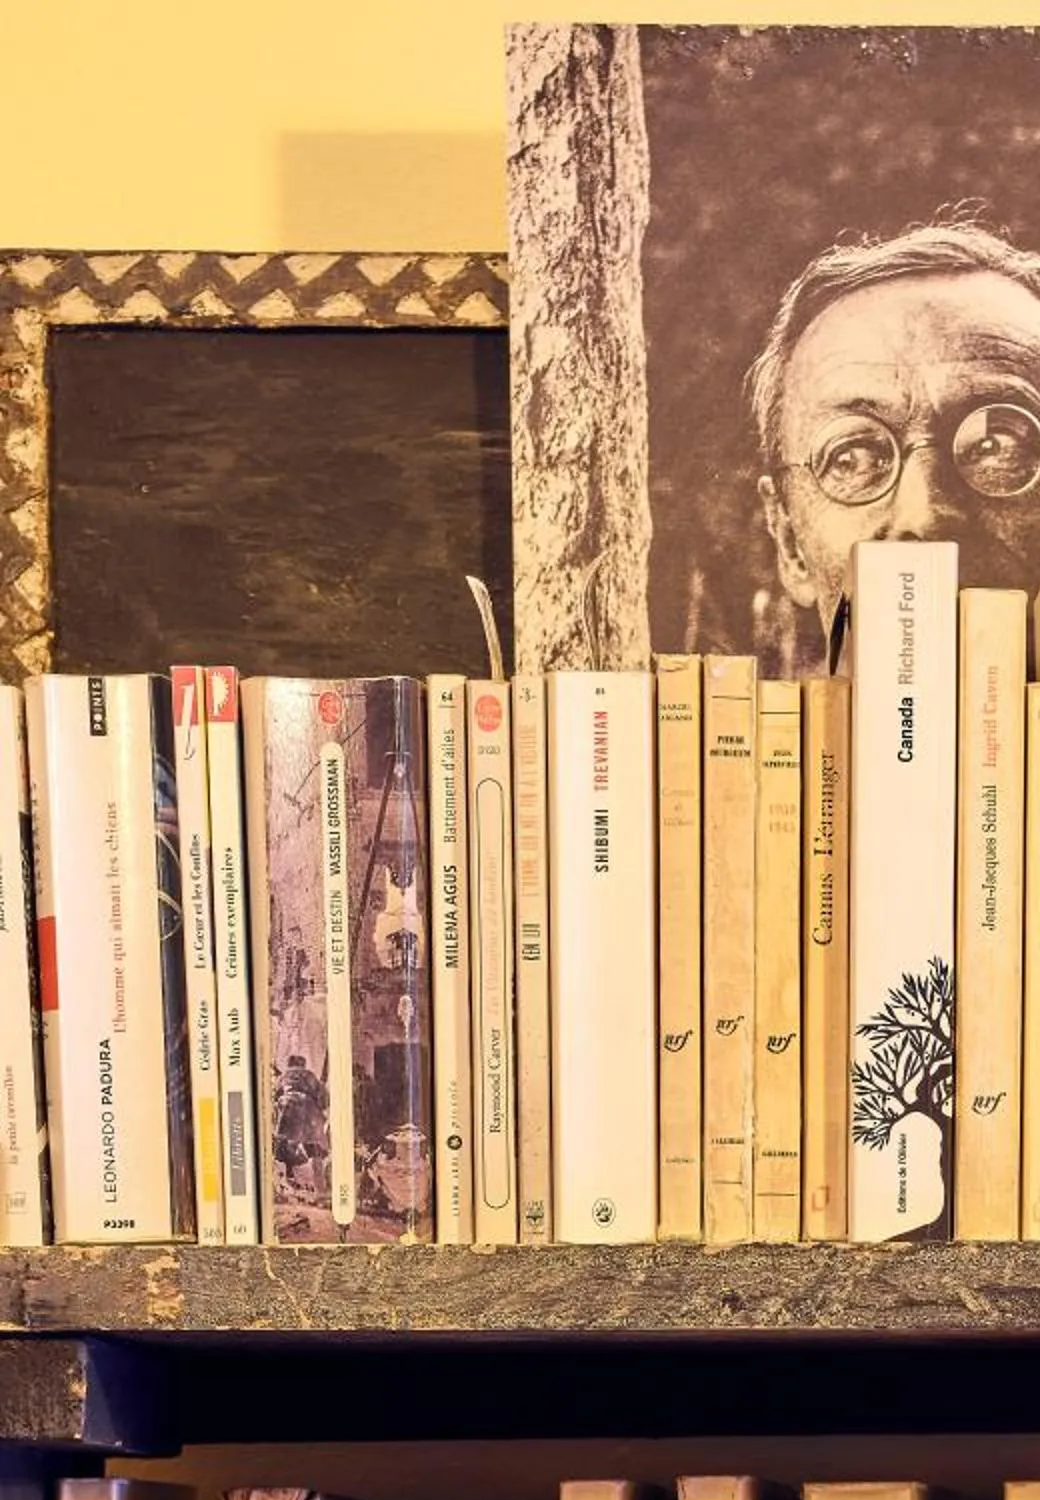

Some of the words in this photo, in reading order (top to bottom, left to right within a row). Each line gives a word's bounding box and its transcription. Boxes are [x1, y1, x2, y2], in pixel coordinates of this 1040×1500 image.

[897, 572, 916, 612] Ford
[897, 619, 916, 685] Richard
[983, 665, 999, 719] Caven
[441, 728, 456, 771] d'ailes
[594, 711, 609, 791] TREVANIAN
[897, 697, 916, 762] Canada
[982, 724, 1000, 767] Ingrid
[326, 758, 340, 827] GROSSMAN
[442, 776, 456, 843] Battement
[812, 750, 837, 856] L'étranger
[981, 785, 997, 832] Schuhl
[328, 830, 341, 876] VASSILI
[594, 809, 609, 873] SHIBUMI
[329, 890, 342, 933] DESTIN
[442, 864, 457, 905] AGUS
[812, 872, 835, 945] Camus
[981, 838, 999, 931] Jean-Jacques
[331, 937, 344, 952] ET
[331, 956, 345, 974] VIE
[443, 912, 458, 969] MILENA
[99, 1039, 113, 1105] PADURA
[101, 1111, 118, 1203] LEONARDO
